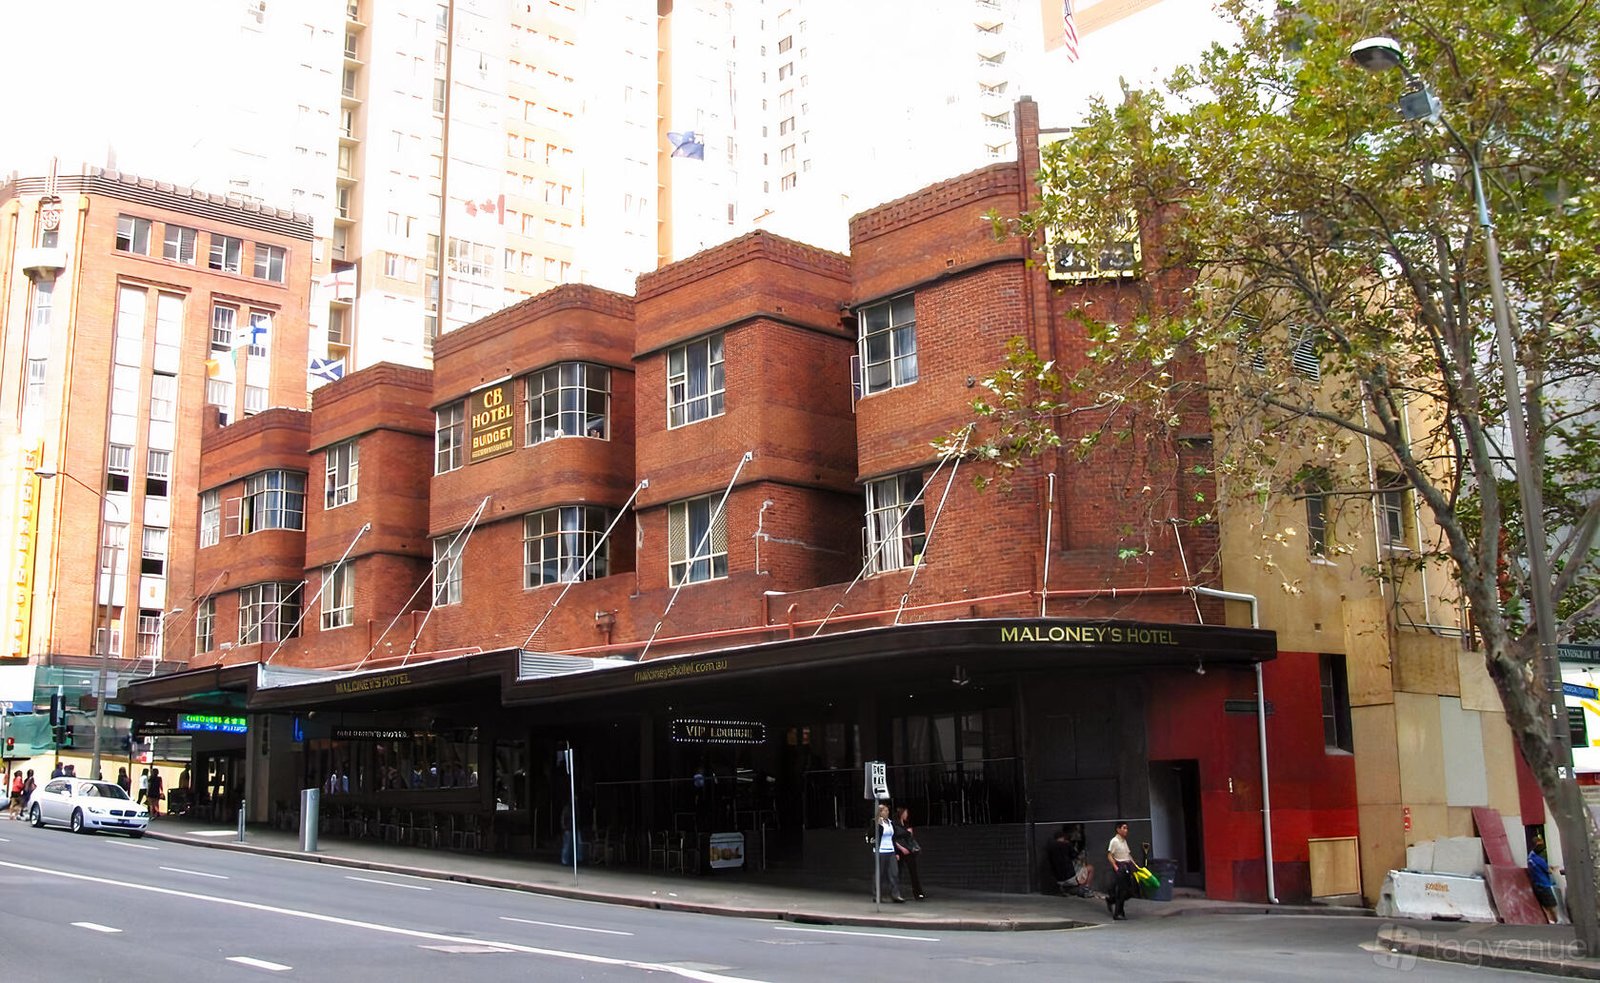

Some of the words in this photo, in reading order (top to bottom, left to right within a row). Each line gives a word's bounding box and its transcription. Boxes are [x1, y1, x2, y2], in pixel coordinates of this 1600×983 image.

[484, 388, 502, 408] CB
[472, 404, 513, 428] HOTEL
[472, 426, 513, 449] BUDGET
[1001, 626, 1123, 643] MALONEY'S
[1127, 628, 1179, 645] HOTEL
[382, 673, 411, 687] HOTEL
[686, 725, 705, 737] VIP
